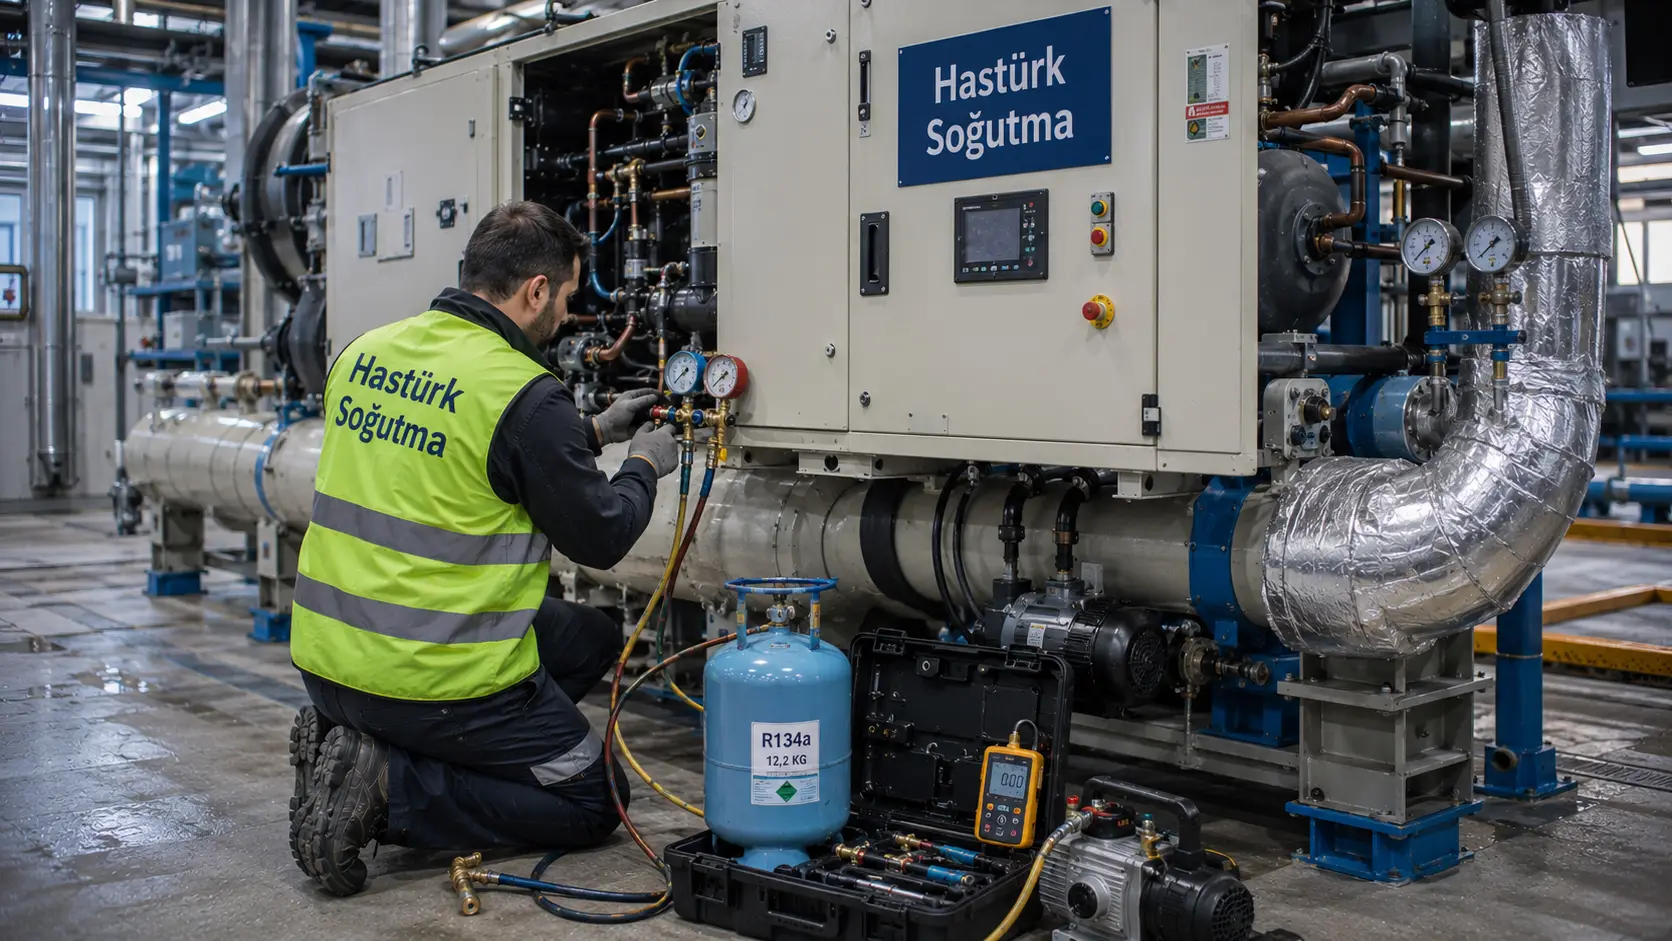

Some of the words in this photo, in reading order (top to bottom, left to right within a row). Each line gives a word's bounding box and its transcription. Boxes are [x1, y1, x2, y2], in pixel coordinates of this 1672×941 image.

[935, 45, 1066, 104] Hastürk
[926, 110, 1074, 160] Soğutma
[348, 352, 465, 414] Hastürk
[335, 395, 447, 458] Soğutma
[762, 732, 811, 748] R134a
[766, 755, 790, 768] 12,2
[792, 754, 807, 766] KG
